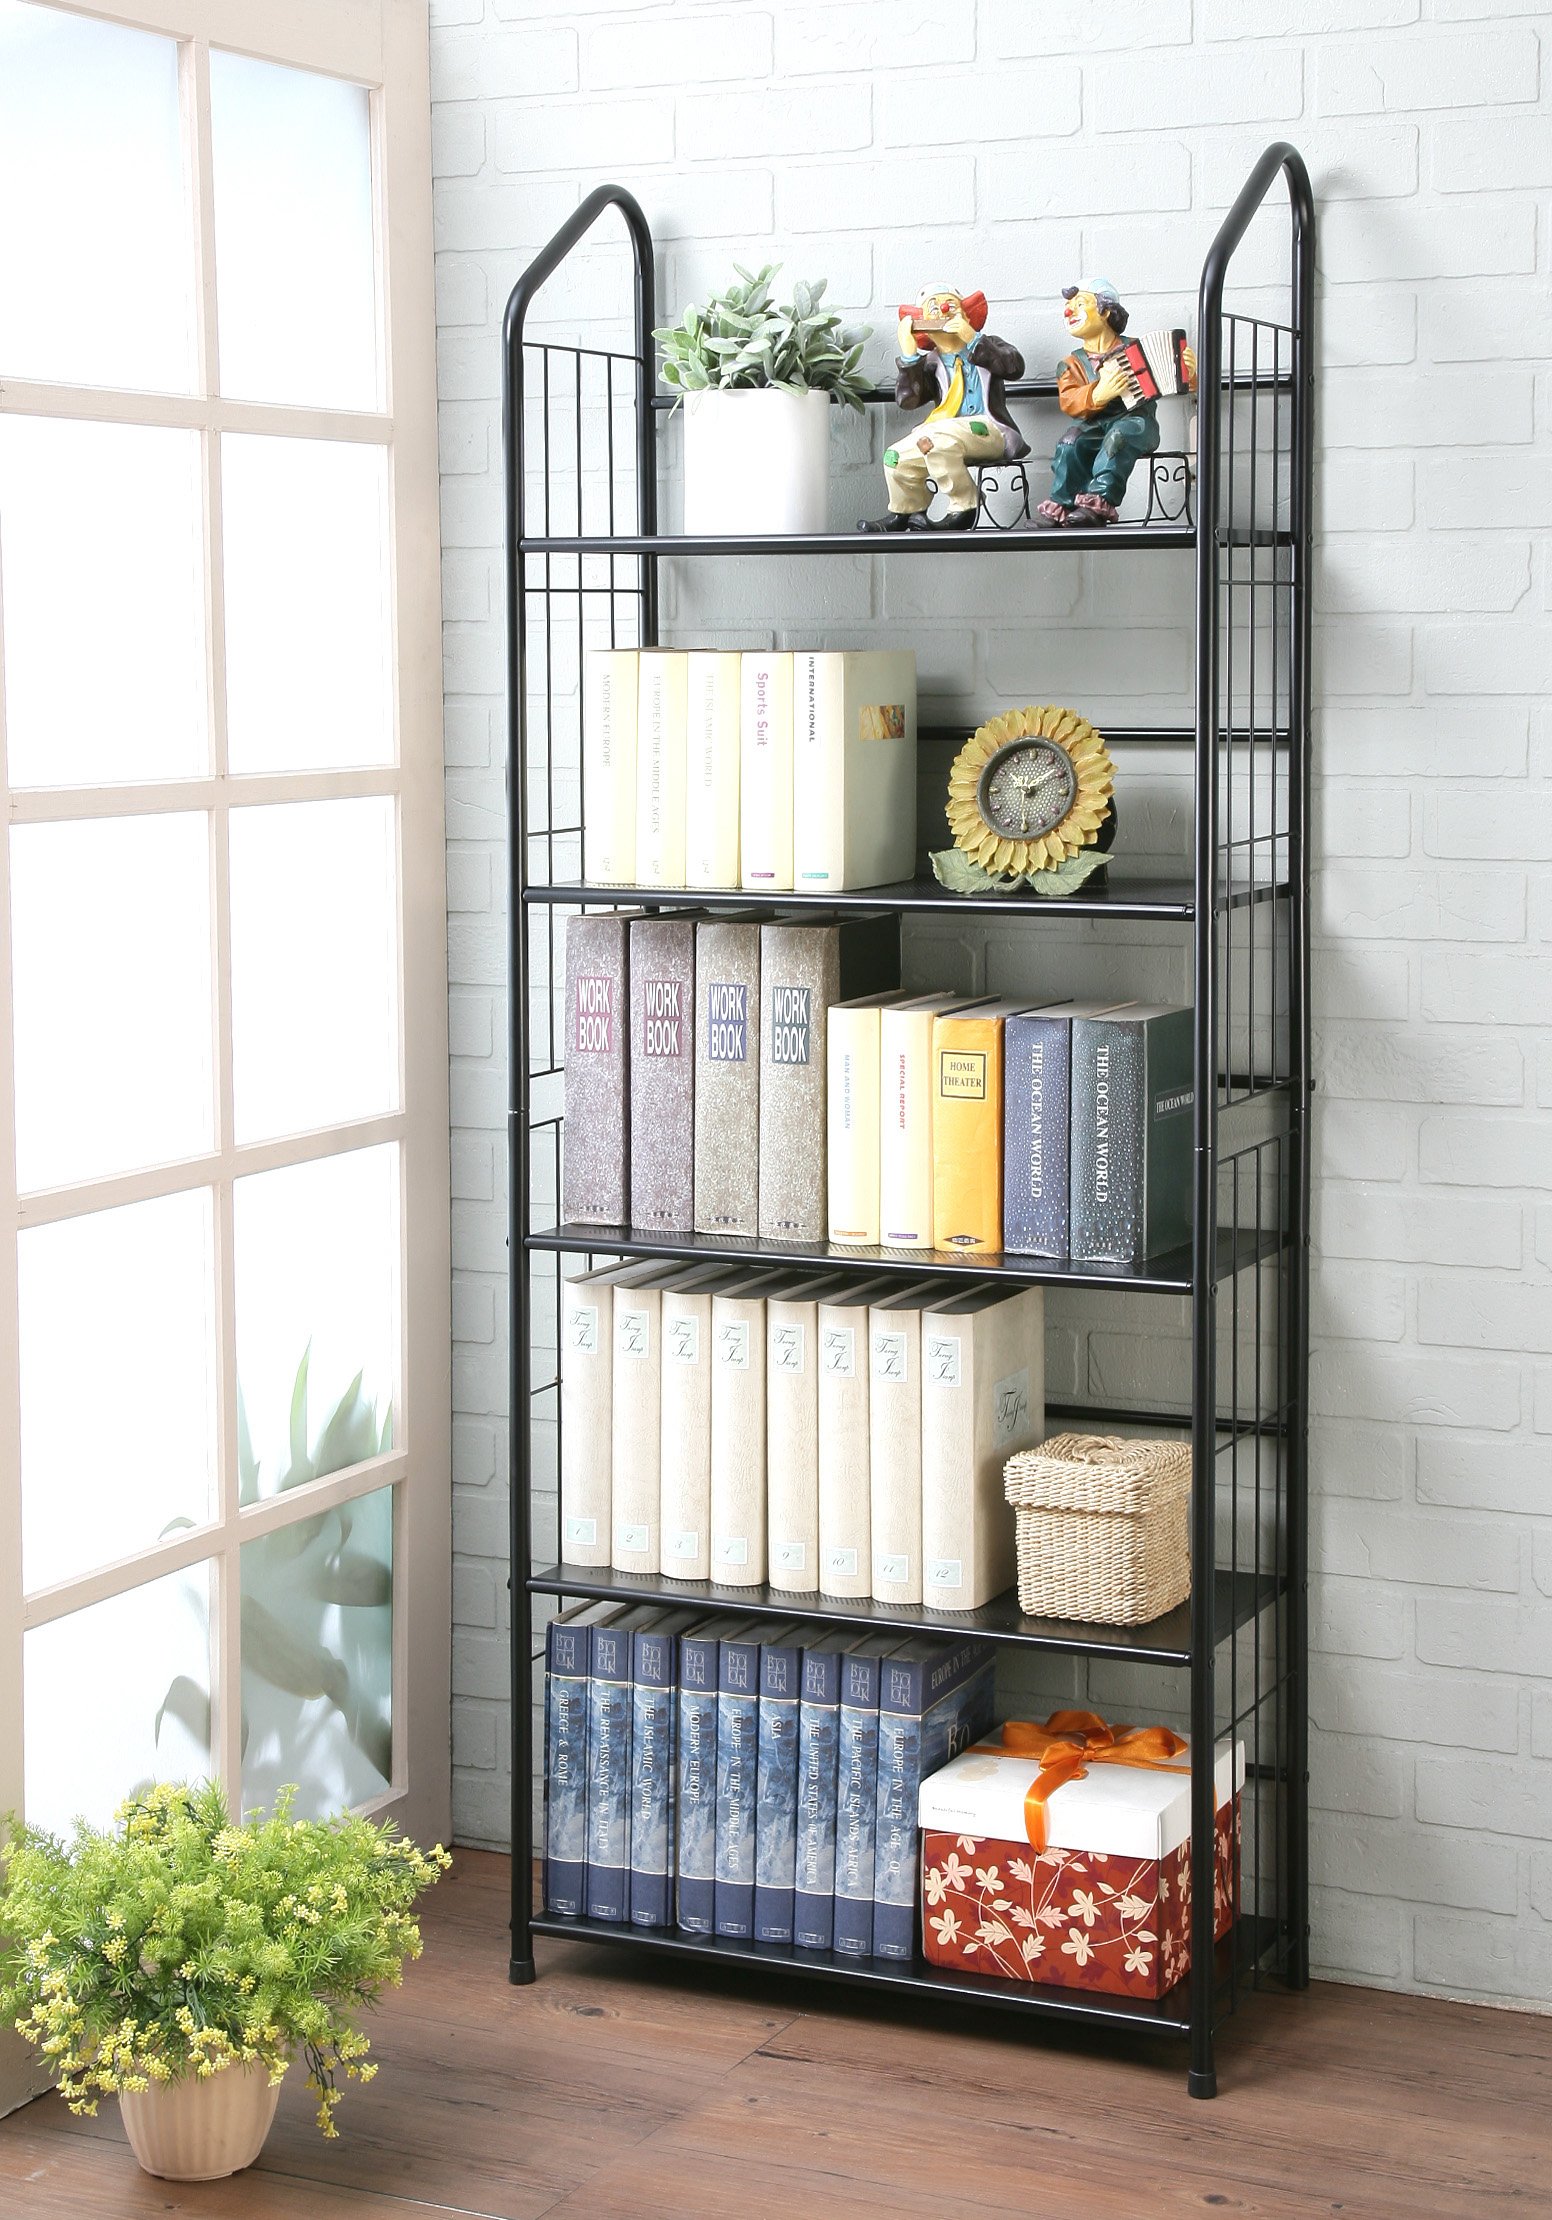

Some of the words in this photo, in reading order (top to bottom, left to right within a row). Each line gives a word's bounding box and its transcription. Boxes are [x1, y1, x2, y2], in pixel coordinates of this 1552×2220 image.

[755, 672, 769, 716] Sports
[808, 656, 816, 743] INTERNATIONAL
[756, 720, 769, 746] Suit
[577, 978, 612, 1014] WORK
[645, 981, 681, 1018] WORK
[710, 985, 745, 1022] WORK
[773, 988, 809, 1025] WORK
[578, 1016, 610, 1051] BOOK
[647, 1019, 680, 1056] BOOK
[711, 1023, 744, 1060] BOOK
[774, 1026, 808, 1063] BOOK
[950, 1061, 976, 1072] HOME
[1031, 1041, 1043, 1075] THE
[1096, 1044, 1110, 1078] THE
[944, 1075, 982, 1088] THEATER
[1030, 1078, 1043, 1135] OCEAN
[1096, 1081, 1109, 1139] OCEAN
[1030, 1138, 1042, 1198] WORLD
[1095, 1142, 1109, 1203] WORLD
[832, 1557, 845, 1567] 10
[935, 1569, 950, 1579] 12
[558, 1689, 569, 1734] GREECE
[600, 1690, 611, 1714] THE
[643, 1697, 655, 1721] THE
[558, 1738, 569, 1748] &
[689, 1705, 700, 1754] MODERN
[730, 1708, 742, 1749] EUROPE
[771, 1713, 782, 1740] ASIA
[809, 1718, 820, 1738] THE
[852, 1718, 863, 1741] THE
[599, 1718, 611, 1797] RENAISSANCE
[642, 1725, 655, 1773] ISLAMIC
[730, 1755, 741, 1767] IN
[808, 1742, 820, 1780] UNITED
[849, 1745, 862, 1789] PACIFIC
[892, 1727, 905, 1773] EUROPE
[557, 1753, 569, 1787] ROME
[689, 1759, 700, 1805] EUROPE
[729, 1772, 741, 1797] THE
[892, 1778, 903, 1792] IN
[598, 1801, 609, 1814] IN
[640, 1778, 652, 1820] WORLD
[728, 1797, 740, 1837] MIDDLE
[807, 1783, 820, 1820] STATES
[849, 1793, 862, 1841] ISLANDS
[891, 1797, 903, 1820] THE
[598, 1819, 610, 1852] ITALY
[890, 1824, 902, 1849] AGE
[728, 1841, 739, 1869] AGES
[806, 1838, 818, 1885] AMERICA
[847, 1846, 859, 1888] AFRICA
[889, 1859, 901, 1877] OF
